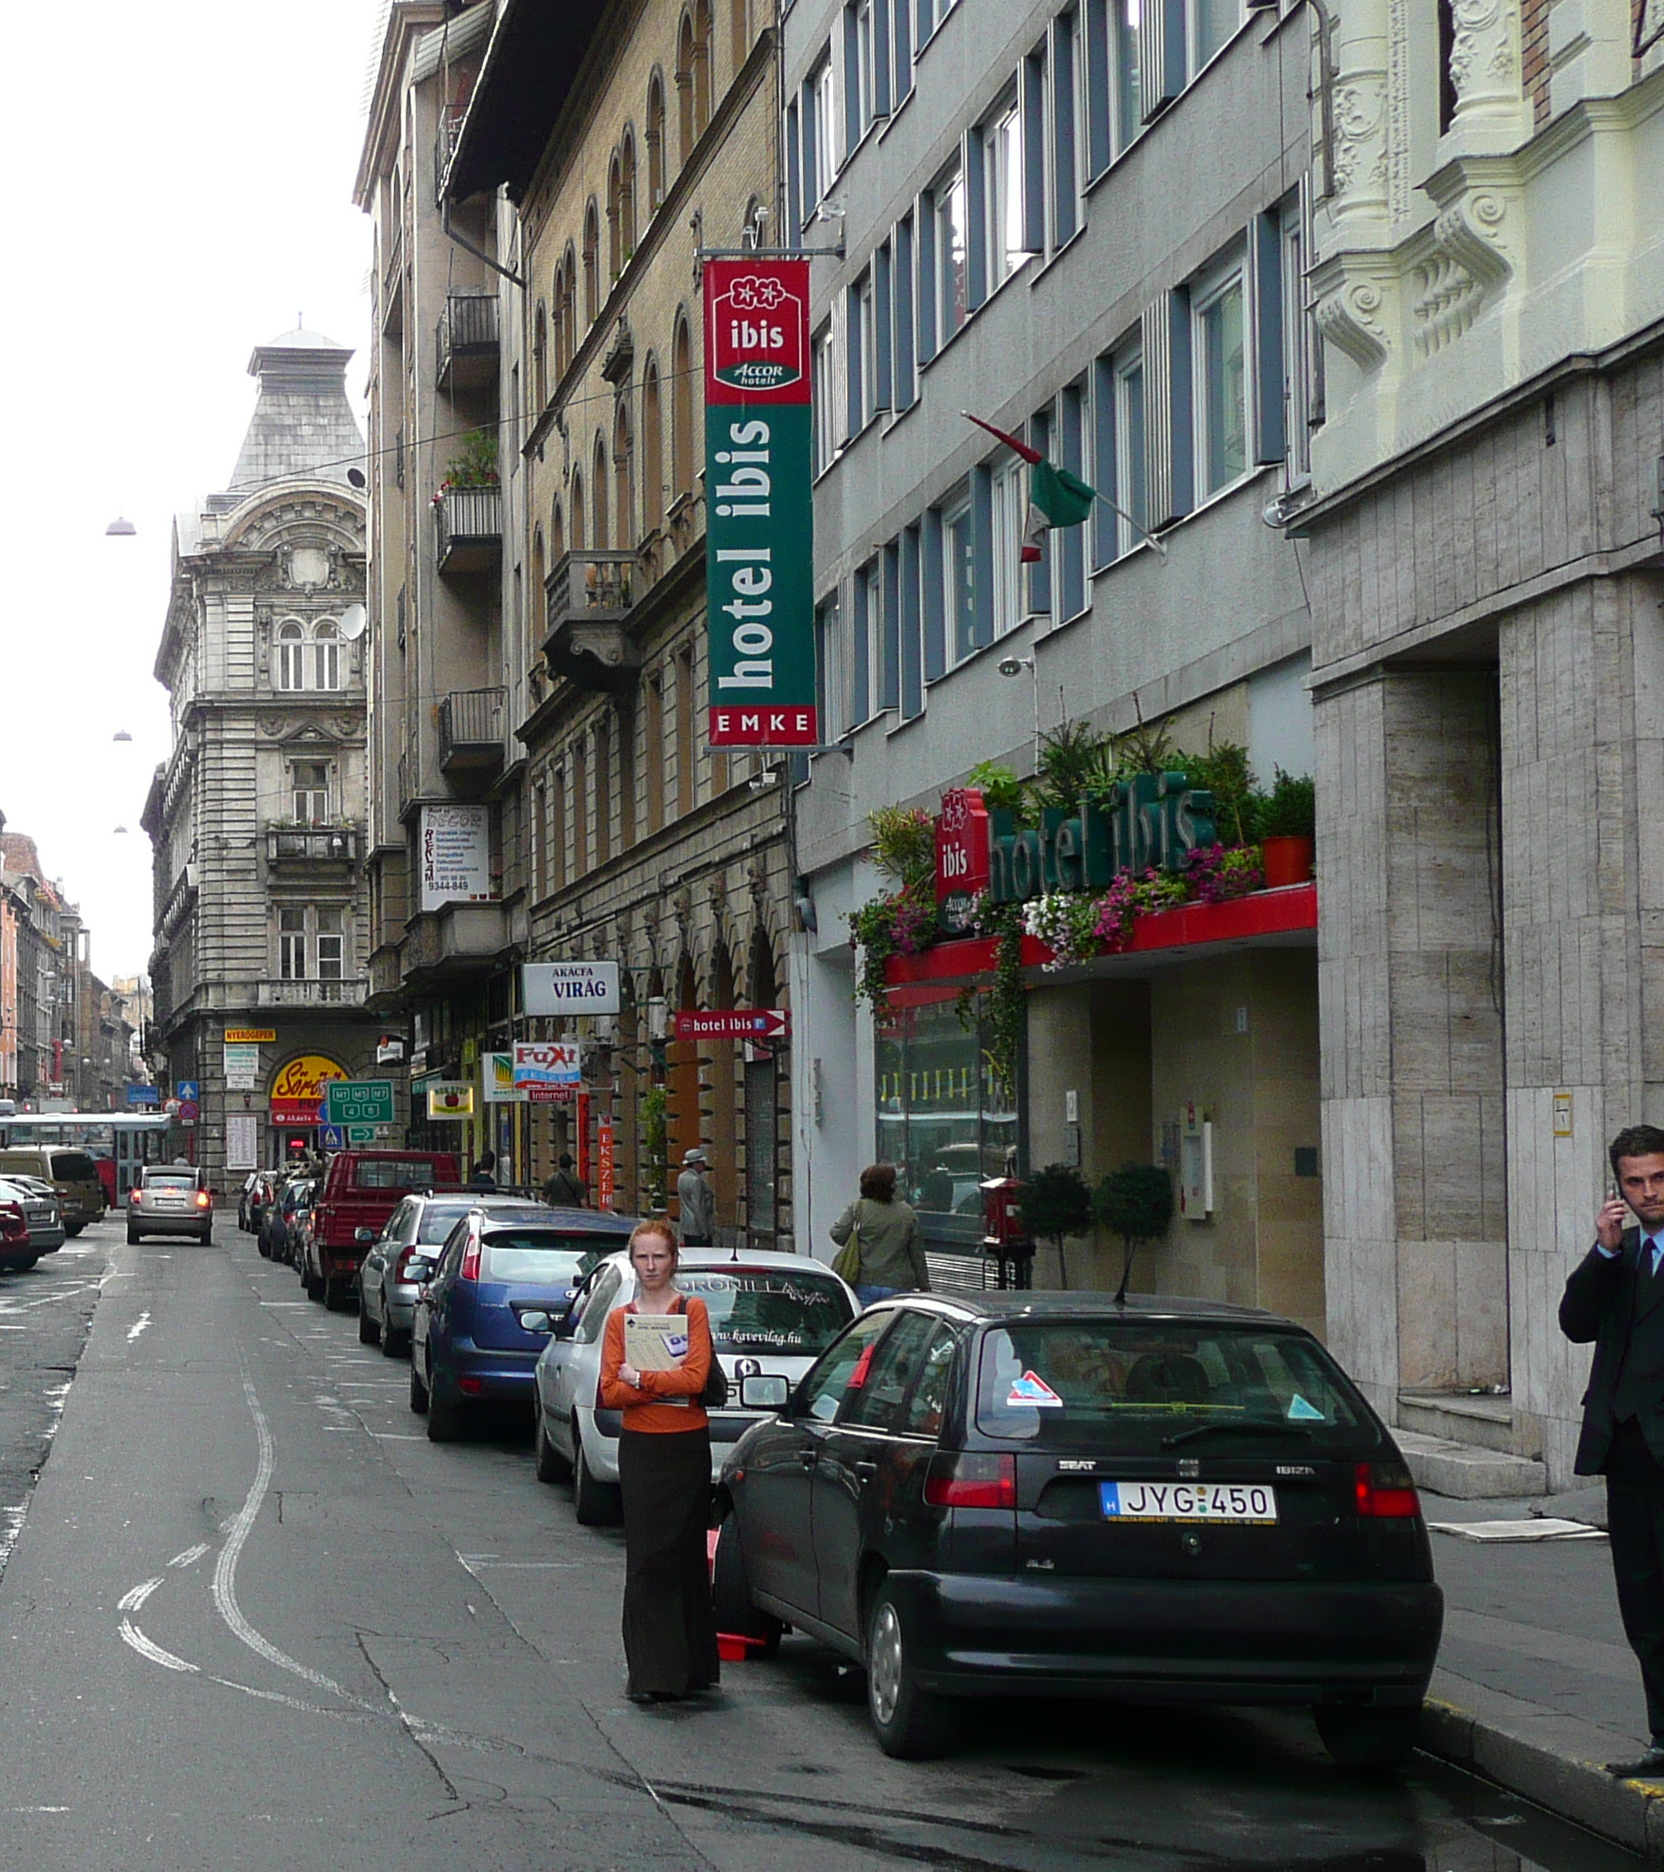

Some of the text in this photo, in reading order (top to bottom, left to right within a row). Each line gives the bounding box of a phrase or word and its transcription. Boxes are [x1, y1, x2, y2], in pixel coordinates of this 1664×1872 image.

[731, 320, 784, 348] ibis
[741, 376, 776, 385] hotels
[715, 420, 773, 689] hotel ibis
[718, 714, 808, 732] EMKE
[987, 772, 1217, 901] hotel ibis
[942, 842, 967, 878] ibis
[553, 979, 606, 998] VIRÁG
[694, 1018, 724, 1031] hotel
[730, 1018, 752, 1029] ibis
[336, 1090, 347, 1099] M1
[374, 1090, 386, 1098] M7
[532, 1090, 568, 1099] Internet
[349, 1107, 355, 1115] 4
[1058, 1460, 1097, 1471] SEAT
[1276, 1466, 1316, 1475] IBIZA
[1106, 1501, 1116, 1511] H
[1127, 1486, 1268, 1514] JYG-450
